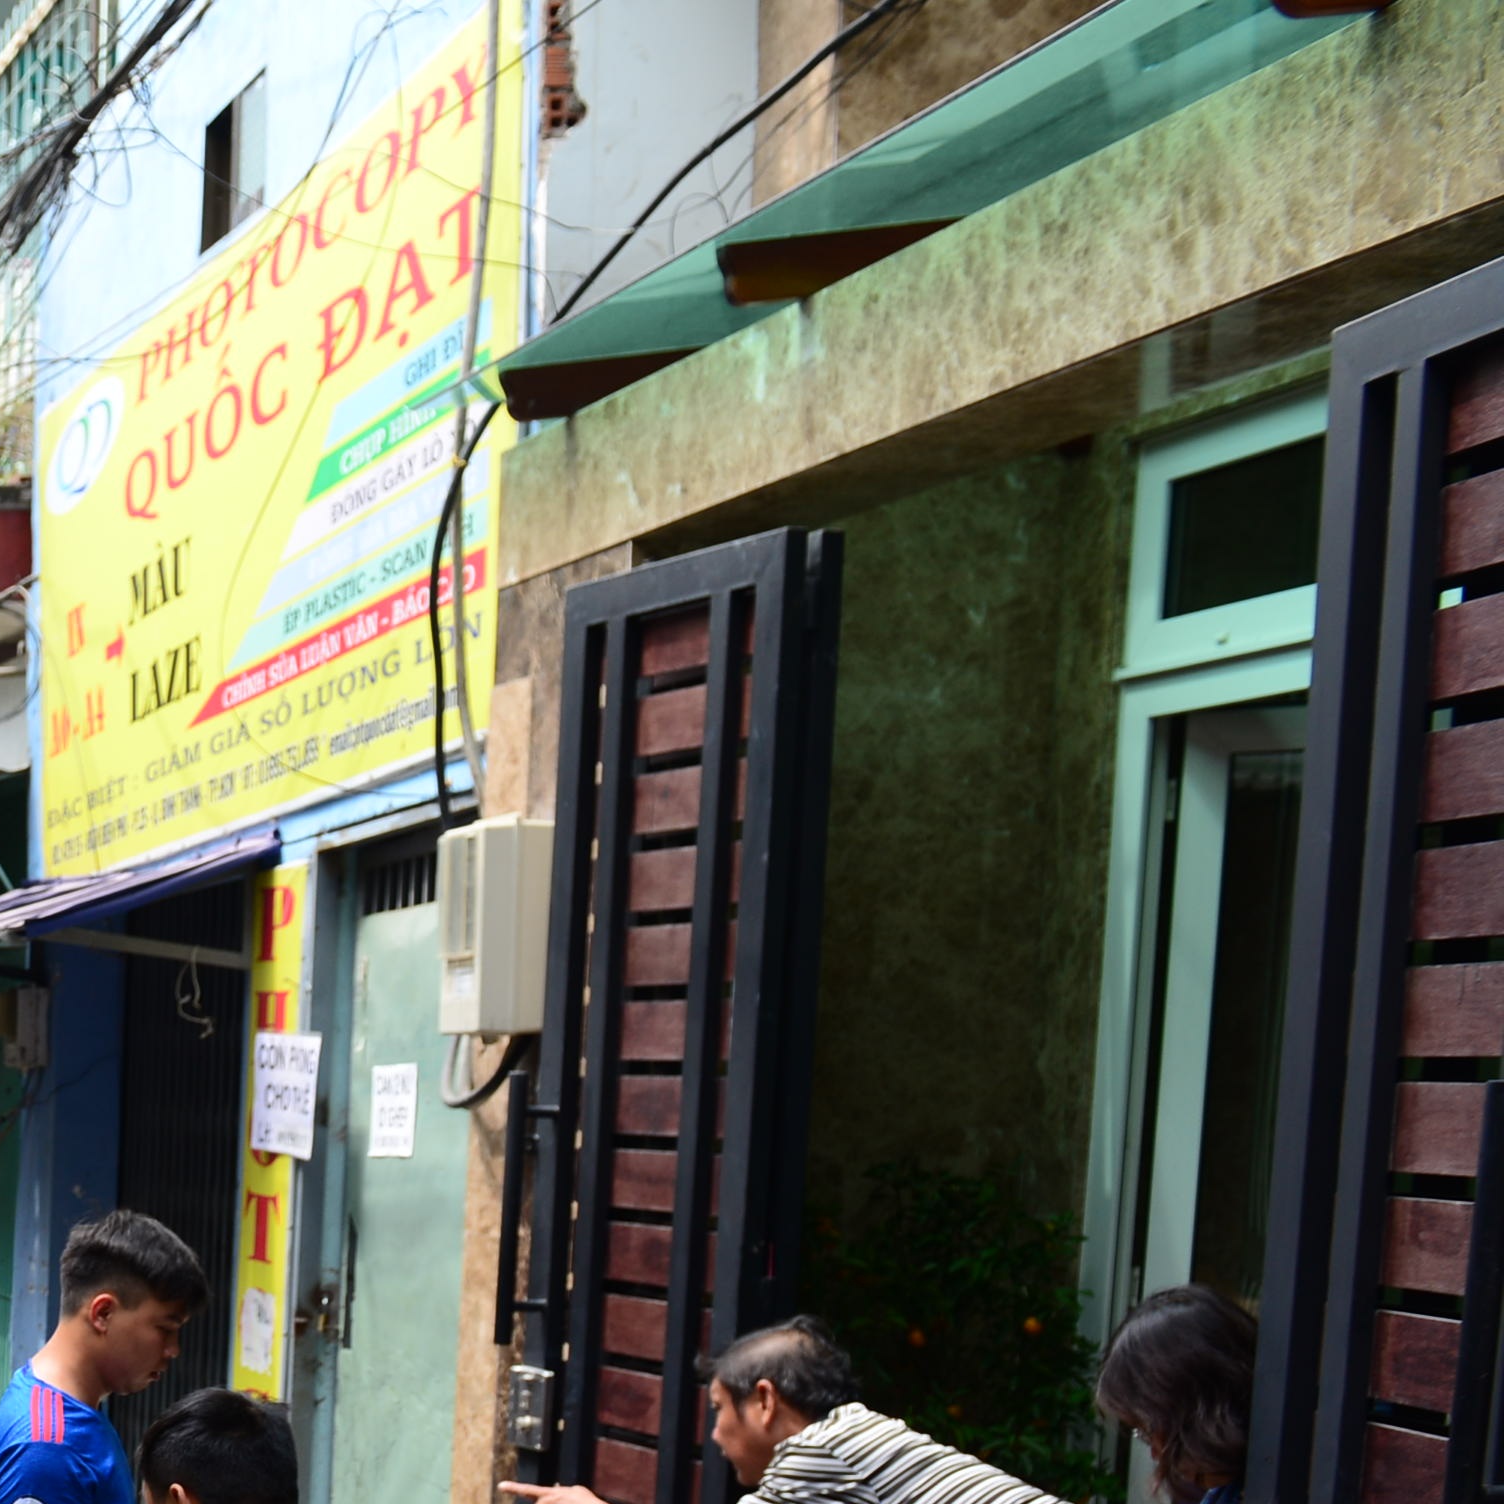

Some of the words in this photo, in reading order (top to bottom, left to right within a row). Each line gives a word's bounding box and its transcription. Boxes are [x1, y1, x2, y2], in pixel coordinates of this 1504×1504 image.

[135, 44, 487, 404] PHOTOCOPY
[125, 342, 288, 521] QUỐC
[317, 184, 481, 382] ĐẠT
[380, 538, 429, 582] SCAN
[130, 634, 202, 724] LAZE
